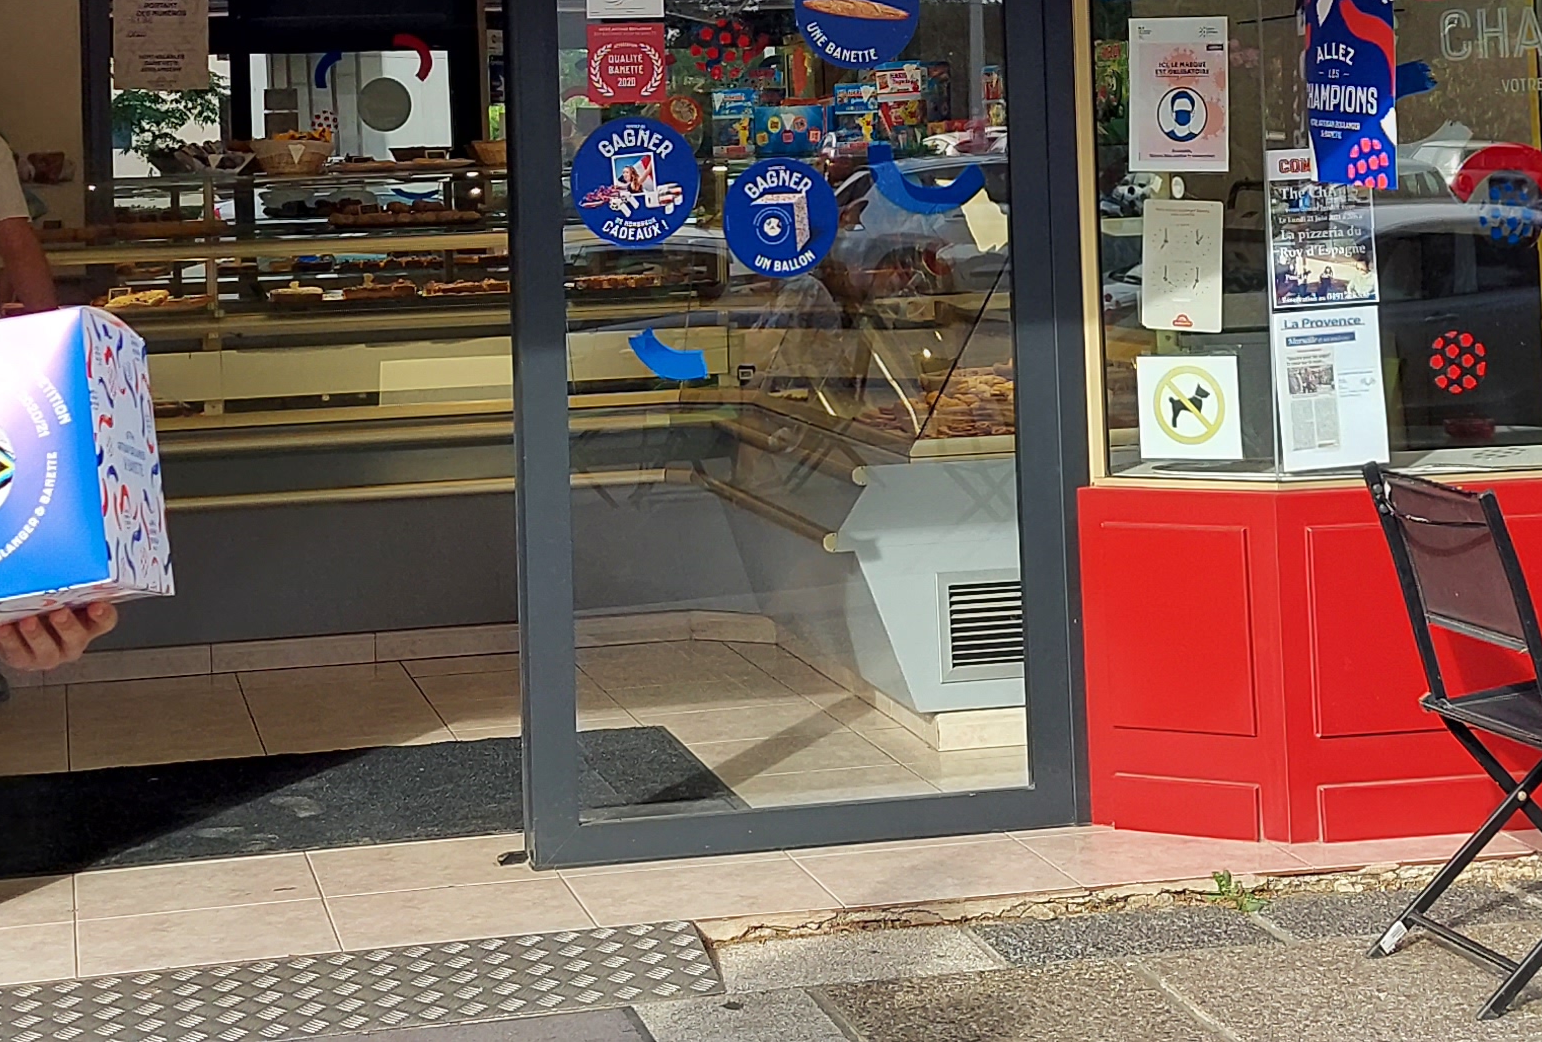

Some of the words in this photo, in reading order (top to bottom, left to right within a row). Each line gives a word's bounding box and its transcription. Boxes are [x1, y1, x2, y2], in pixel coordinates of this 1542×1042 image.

[806, 21, 828, 47] UNE
[824, 41, 879, 63] BANETTE
[1316, 42, 1355, 66] ALLEZ
[608, 65, 644, 75] BANETTE
[617, 77, 636, 87] 2020
[1306, 83, 1378, 116] HAMPIONS
[598, 129, 674, 159] GAGNER
[744, 170, 812, 199] GAGNER
[602, 220, 662, 241] CADEAUX
[1281, 229, 1295, 240] La
[1298, 225, 1344, 241] pizzeria
[1346, 224, 1362, 237] du
[755, 255, 772, 271] UN
[773, 250, 816, 272] BALLON
[1280, 247, 1304, 260] Roy
[1305, 242, 1367, 258] d'Espagne
[1284, 319, 1298, 329] La
[1301, 316, 1362, 328] Provence
